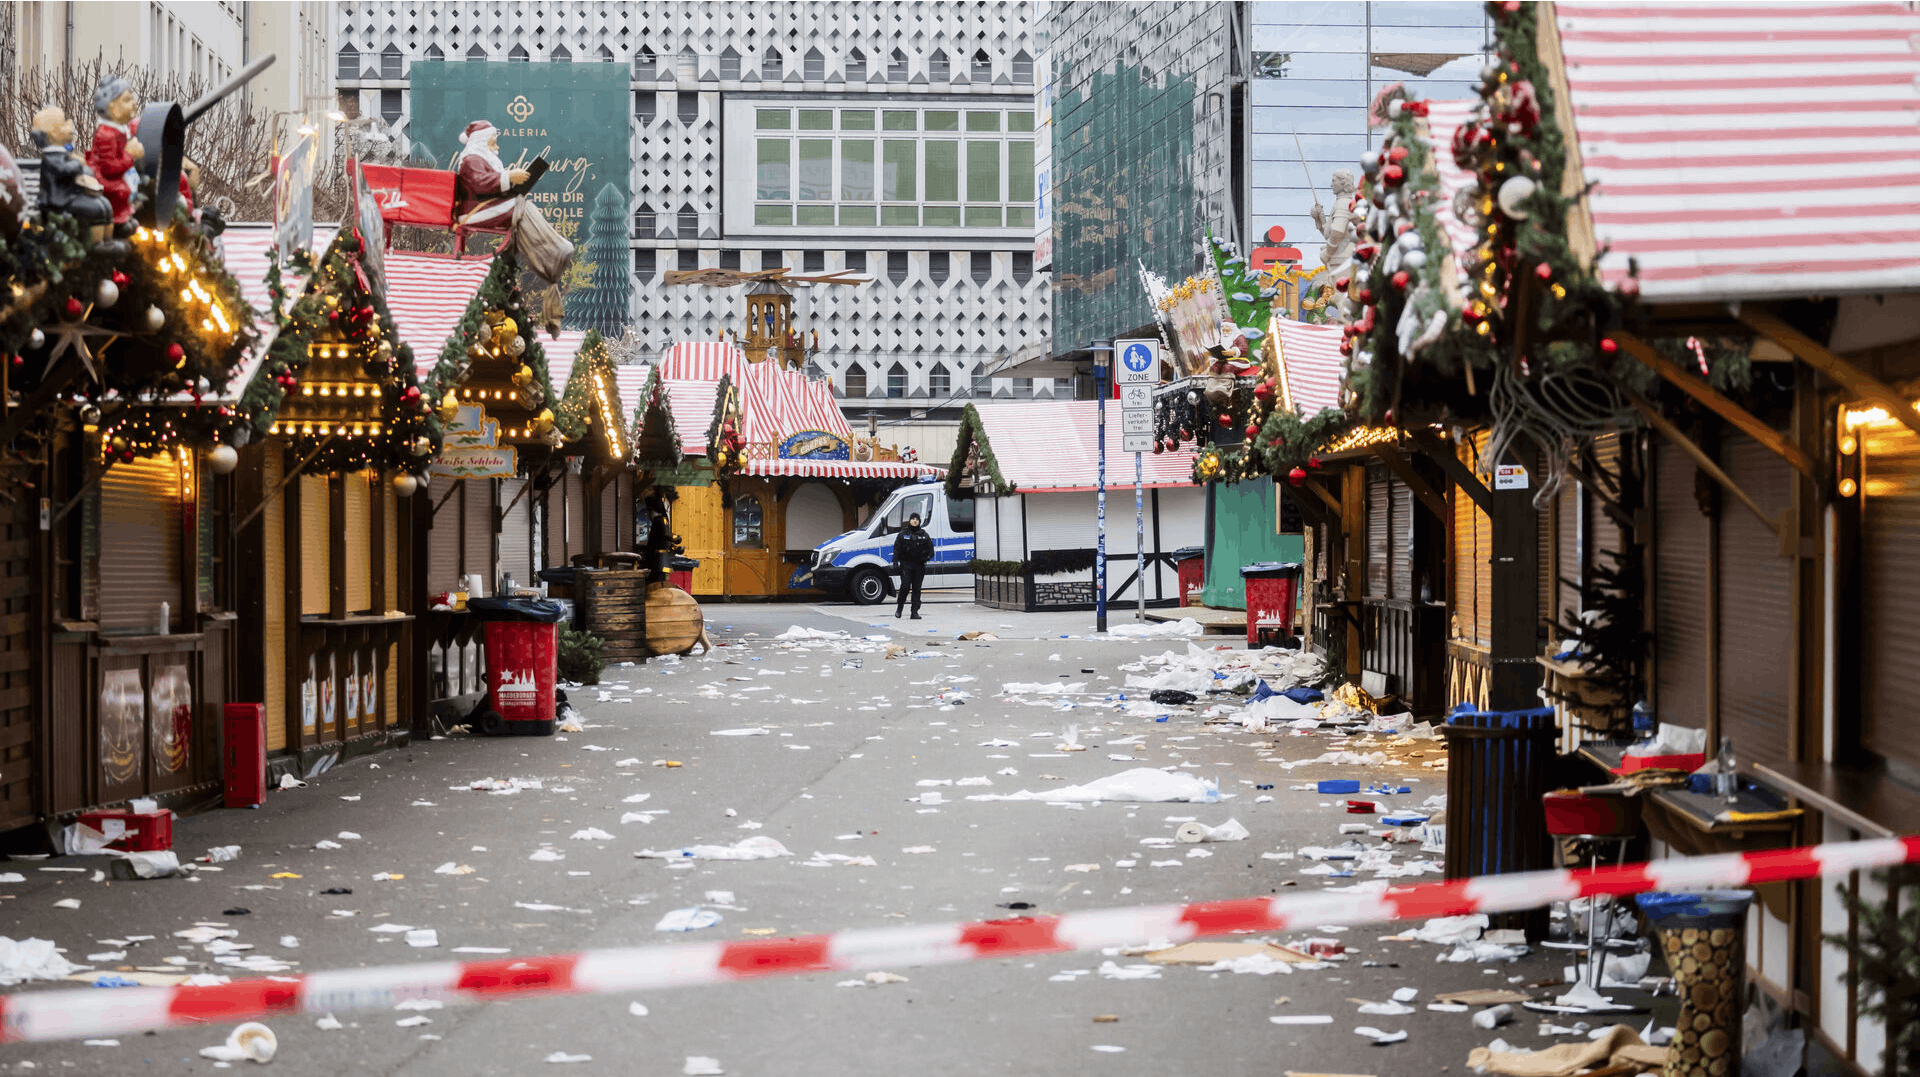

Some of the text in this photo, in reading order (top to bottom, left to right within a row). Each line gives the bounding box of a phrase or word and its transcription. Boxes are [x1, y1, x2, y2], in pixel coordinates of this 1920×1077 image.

[496, 128, 548, 137] GALERIA
[525, 192, 584, 203] CHEN DIR
[538, 207, 584, 218] VOLLE
[1127, 373, 1150, 382] ZONE
